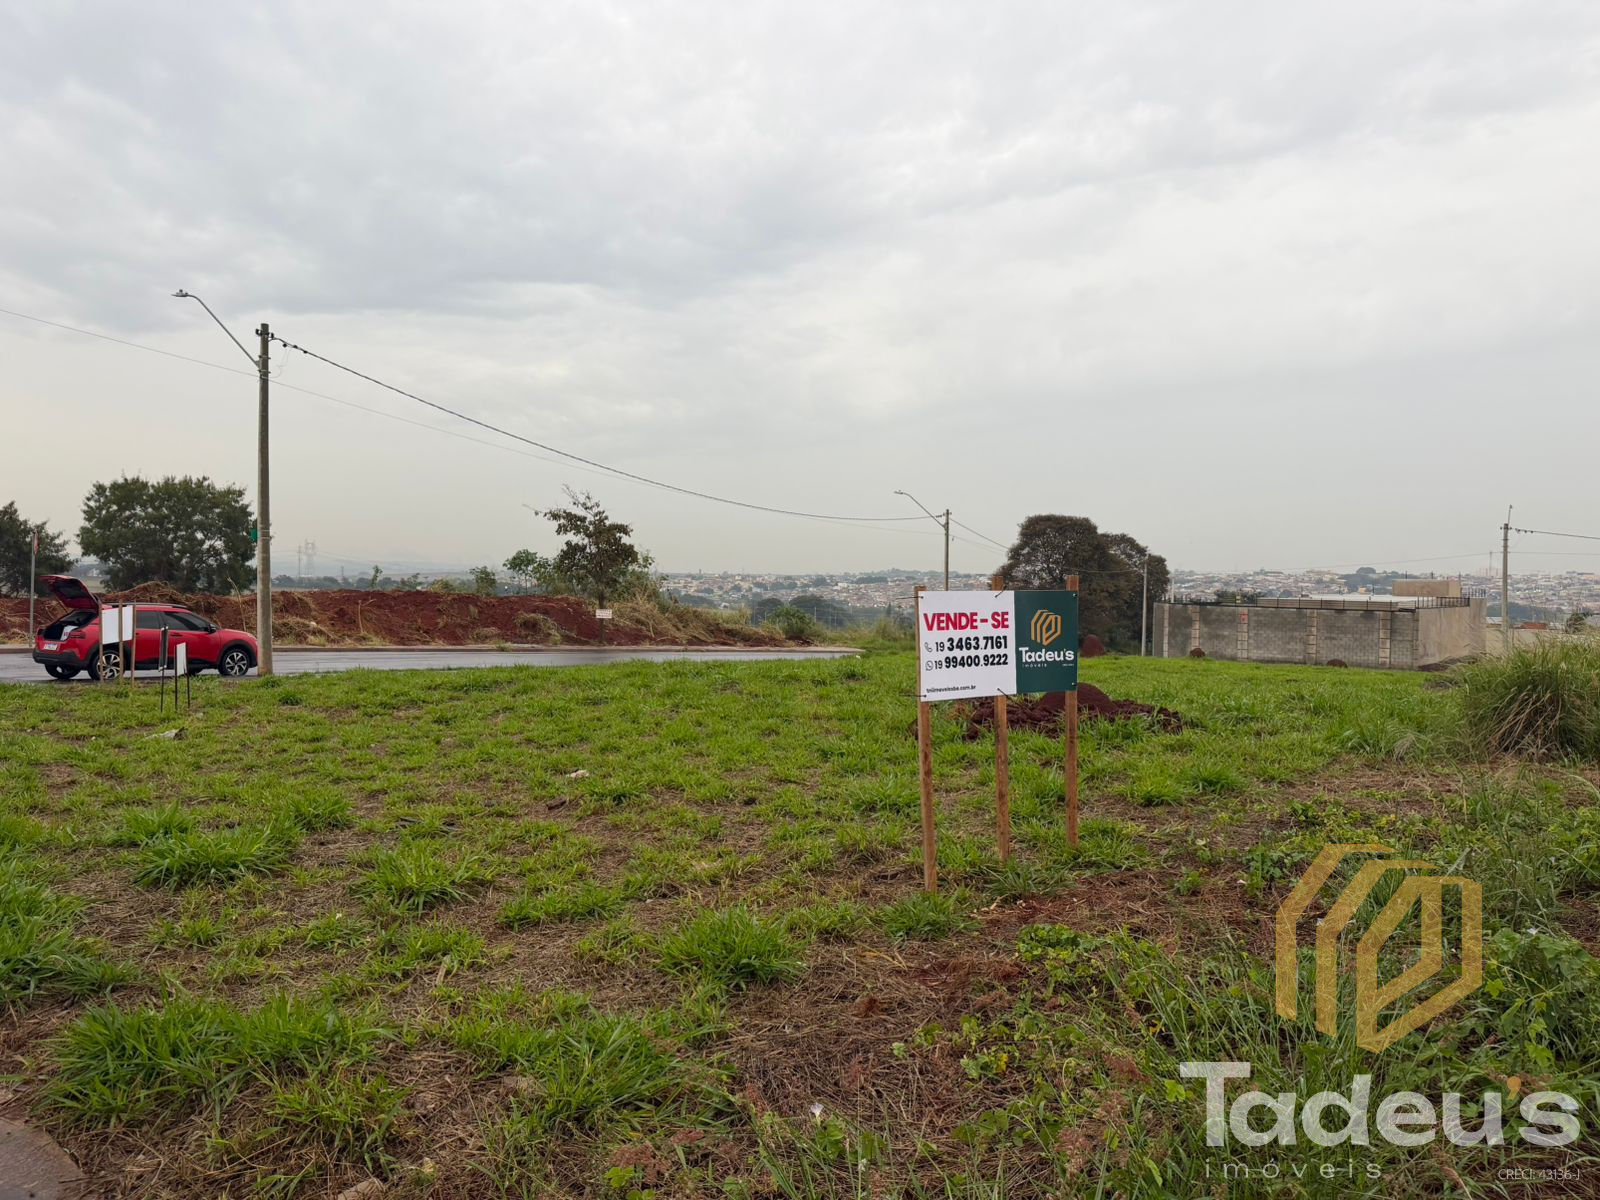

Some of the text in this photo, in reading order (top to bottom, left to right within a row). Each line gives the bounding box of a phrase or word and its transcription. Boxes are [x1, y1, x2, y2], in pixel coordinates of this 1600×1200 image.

[923, 611, 1009, 631] VENDE-SE
[935, 635, 1008, 652] 19 3463.7161
[934, 653, 1009, 670] 19 99400.9222
[1018, 647, 1075, 662] Tadeu's
